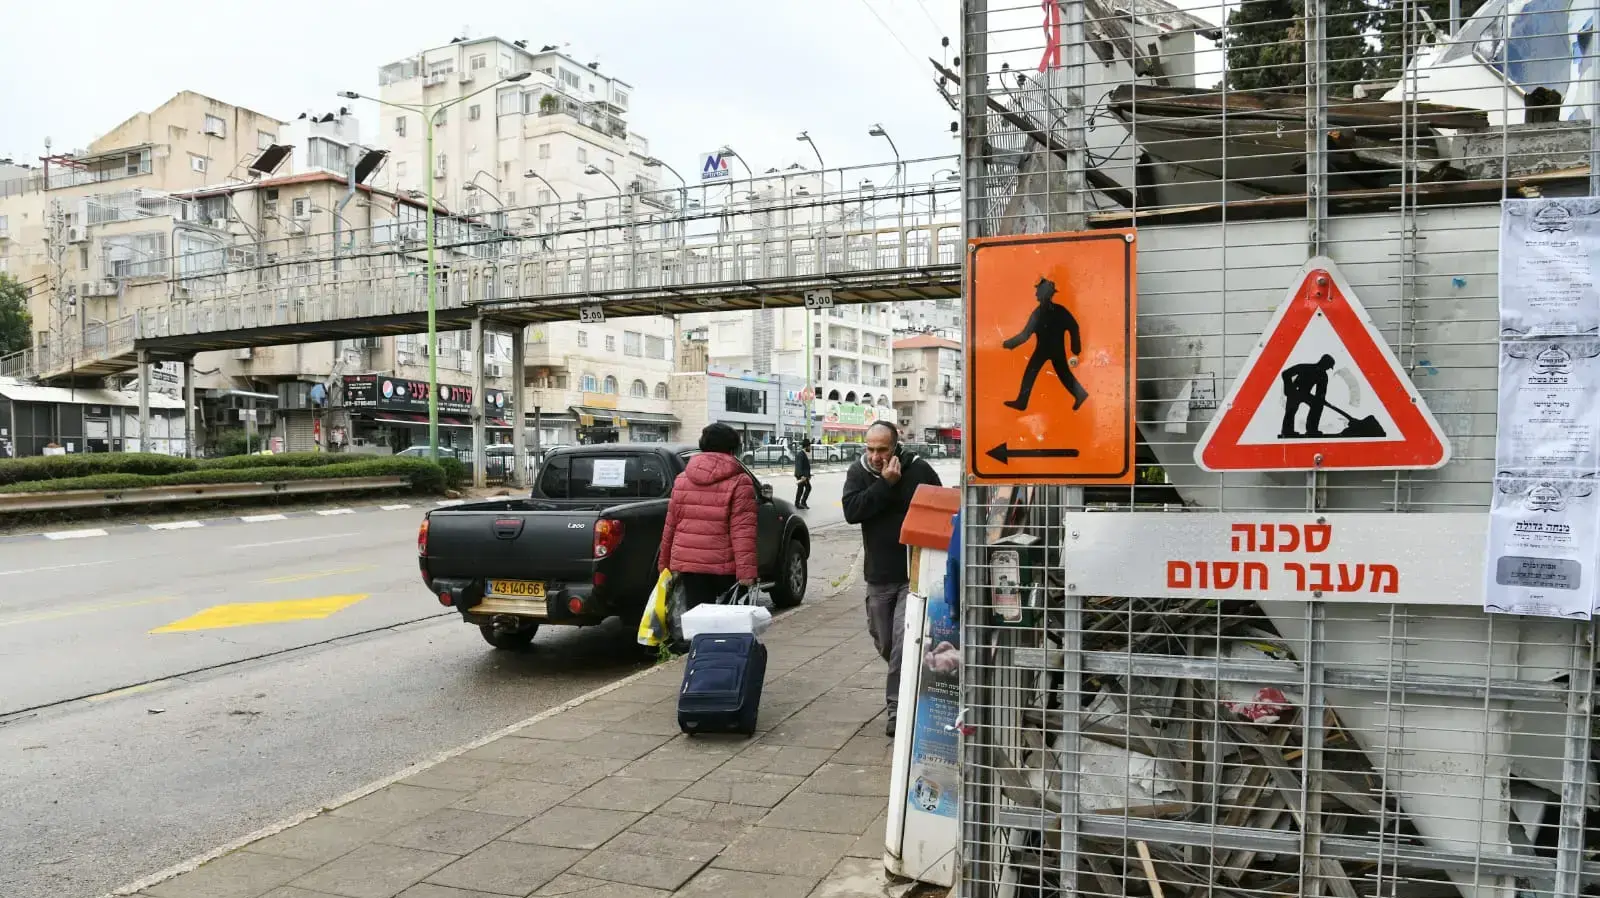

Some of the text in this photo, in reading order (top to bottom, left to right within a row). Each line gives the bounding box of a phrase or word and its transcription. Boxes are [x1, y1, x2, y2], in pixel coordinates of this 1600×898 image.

[807, 295, 831, 306] 5.00
[582, 309, 602, 320] 5.00
[1515, 520, 1570, 532] מנחה גדולה
[1231, 523, 1332, 553] סכנה
[1166, 560, 1399, 593] מעבר חסום
